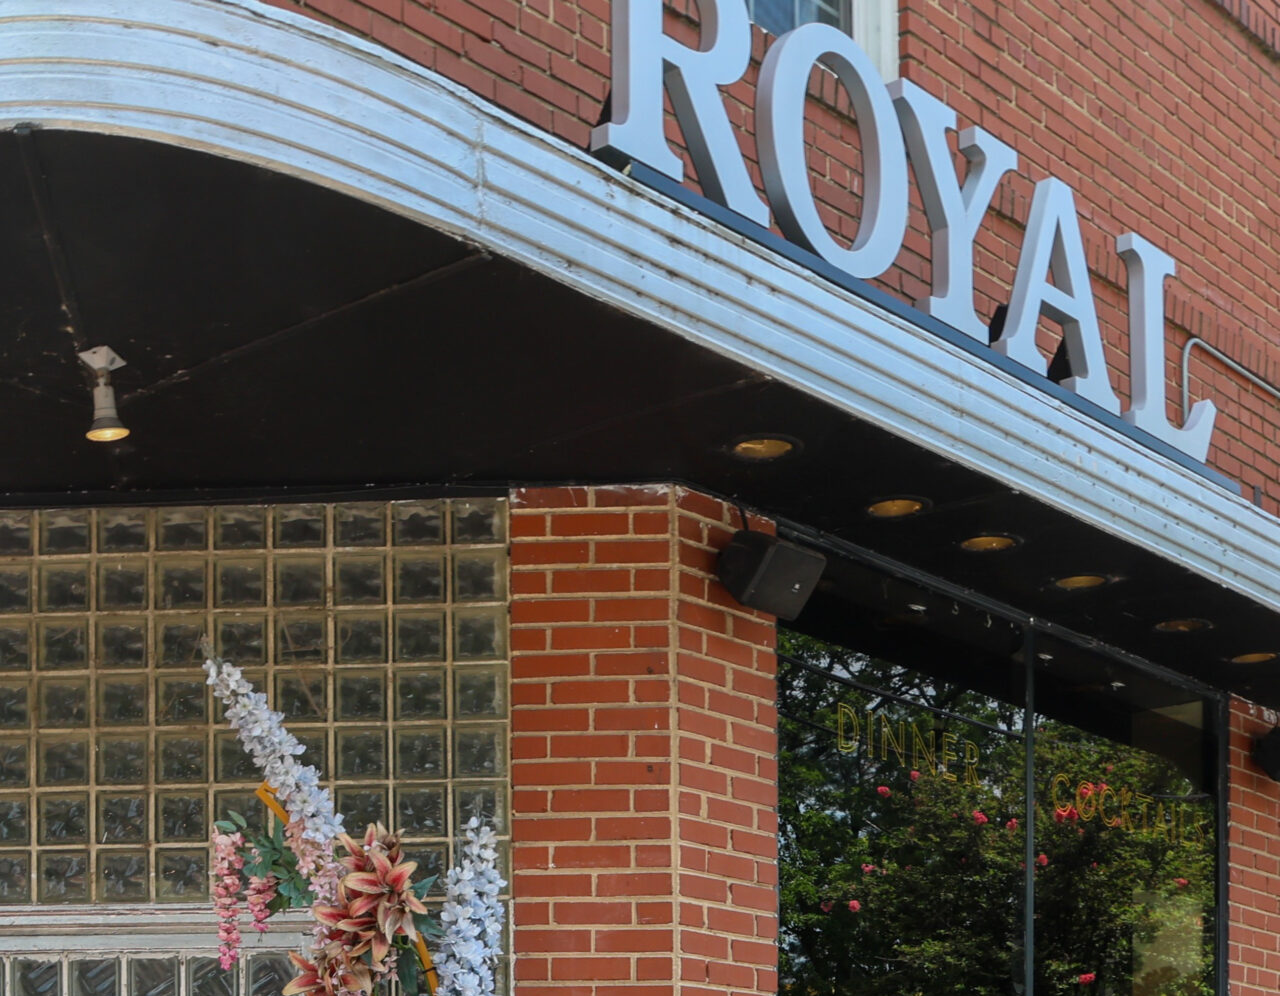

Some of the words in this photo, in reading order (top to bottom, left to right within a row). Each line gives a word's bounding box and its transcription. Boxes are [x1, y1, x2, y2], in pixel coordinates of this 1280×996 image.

[590, 0, 1217, 464] ROYAL
[837, 701, 981, 788] DINNER
[1052, 773, 1205, 850] COCKTAILS
